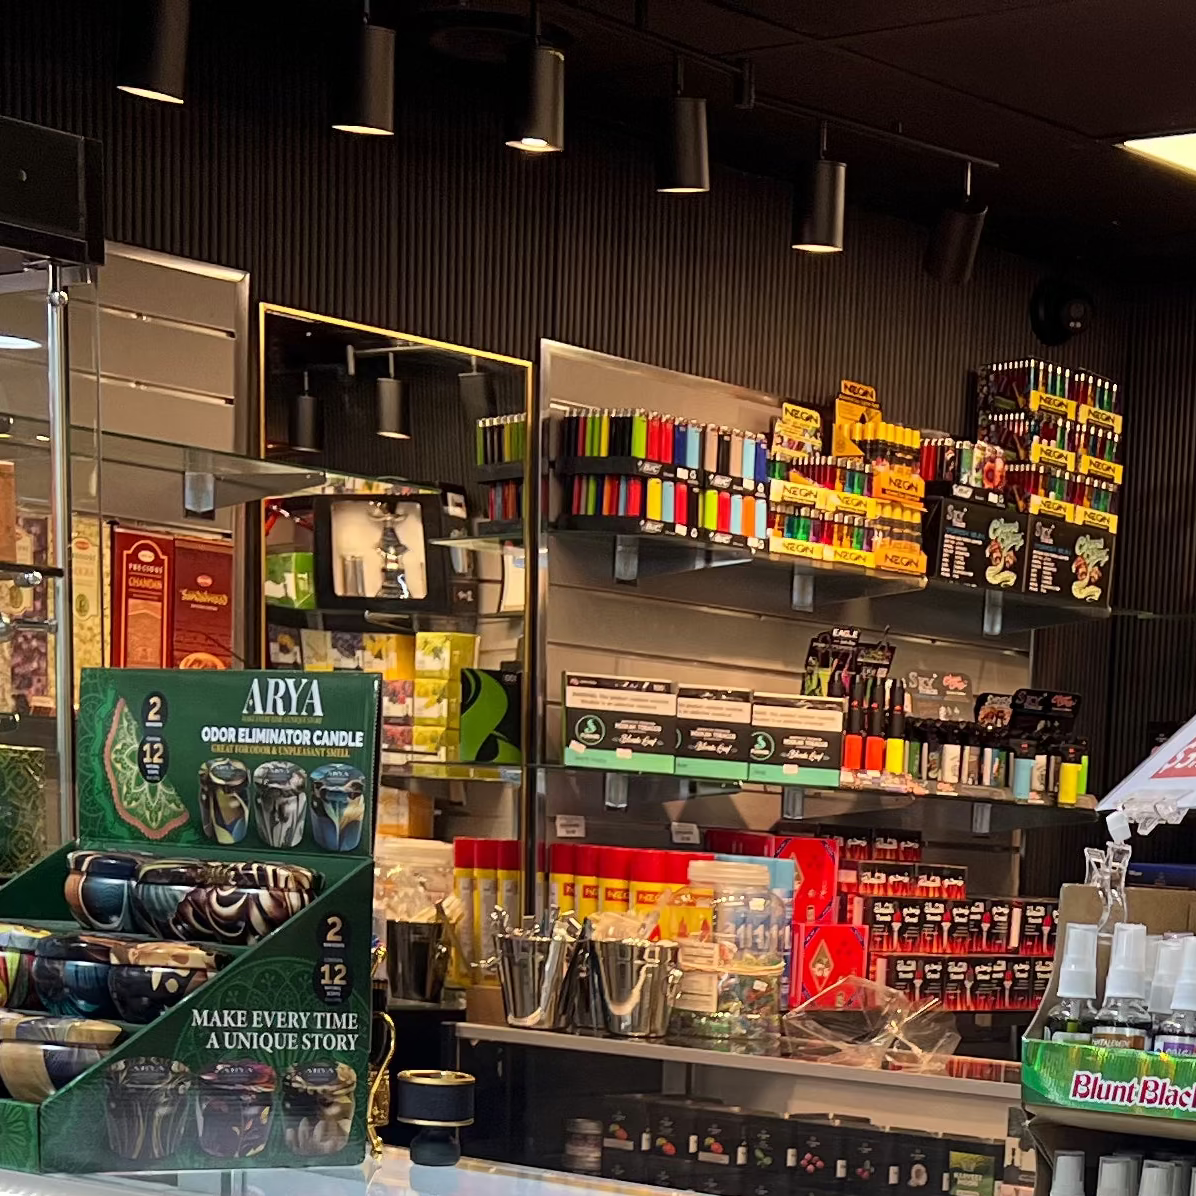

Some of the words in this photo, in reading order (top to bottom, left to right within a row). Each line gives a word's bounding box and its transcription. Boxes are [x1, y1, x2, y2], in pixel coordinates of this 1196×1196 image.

[1039, 393, 1068, 410] NEON
[1088, 408, 1116, 424] NEON
[1040, 445, 1068, 462] NEON
[1089, 459, 1116, 476] NEON
[241, 677, 324, 717] ARYA
[148, 696, 162, 721] 2
[201, 726, 237, 743] ODOR
[237, 727, 311, 746] ELIMINATOR
[312, 730, 365, 748] CANDLE
[142, 743, 164, 764] 12
[211, 744, 235, 753] GREAT
[235, 745, 250, 754] FOR
[250, 745, 272, 755] ODOR
[278, 747, 326, 757] UNPLEASANT
[326, 748, 351, 758] SMELL
[326, 916, 343, 942] 2
[320, 963, 347, 985] 12
[191, 1009, 248, 1028] MAKE
[251, 1010, 311, 1029] EVERY
[313, 1012, 359, 1030] TIME
[205, 1032, 220, 1049] A
[223, 1032, 299, 1054] UNIQUE
[301, 1033, 359, 1051] STORY
[1072, 1072, 1135, 1104] Blunt
